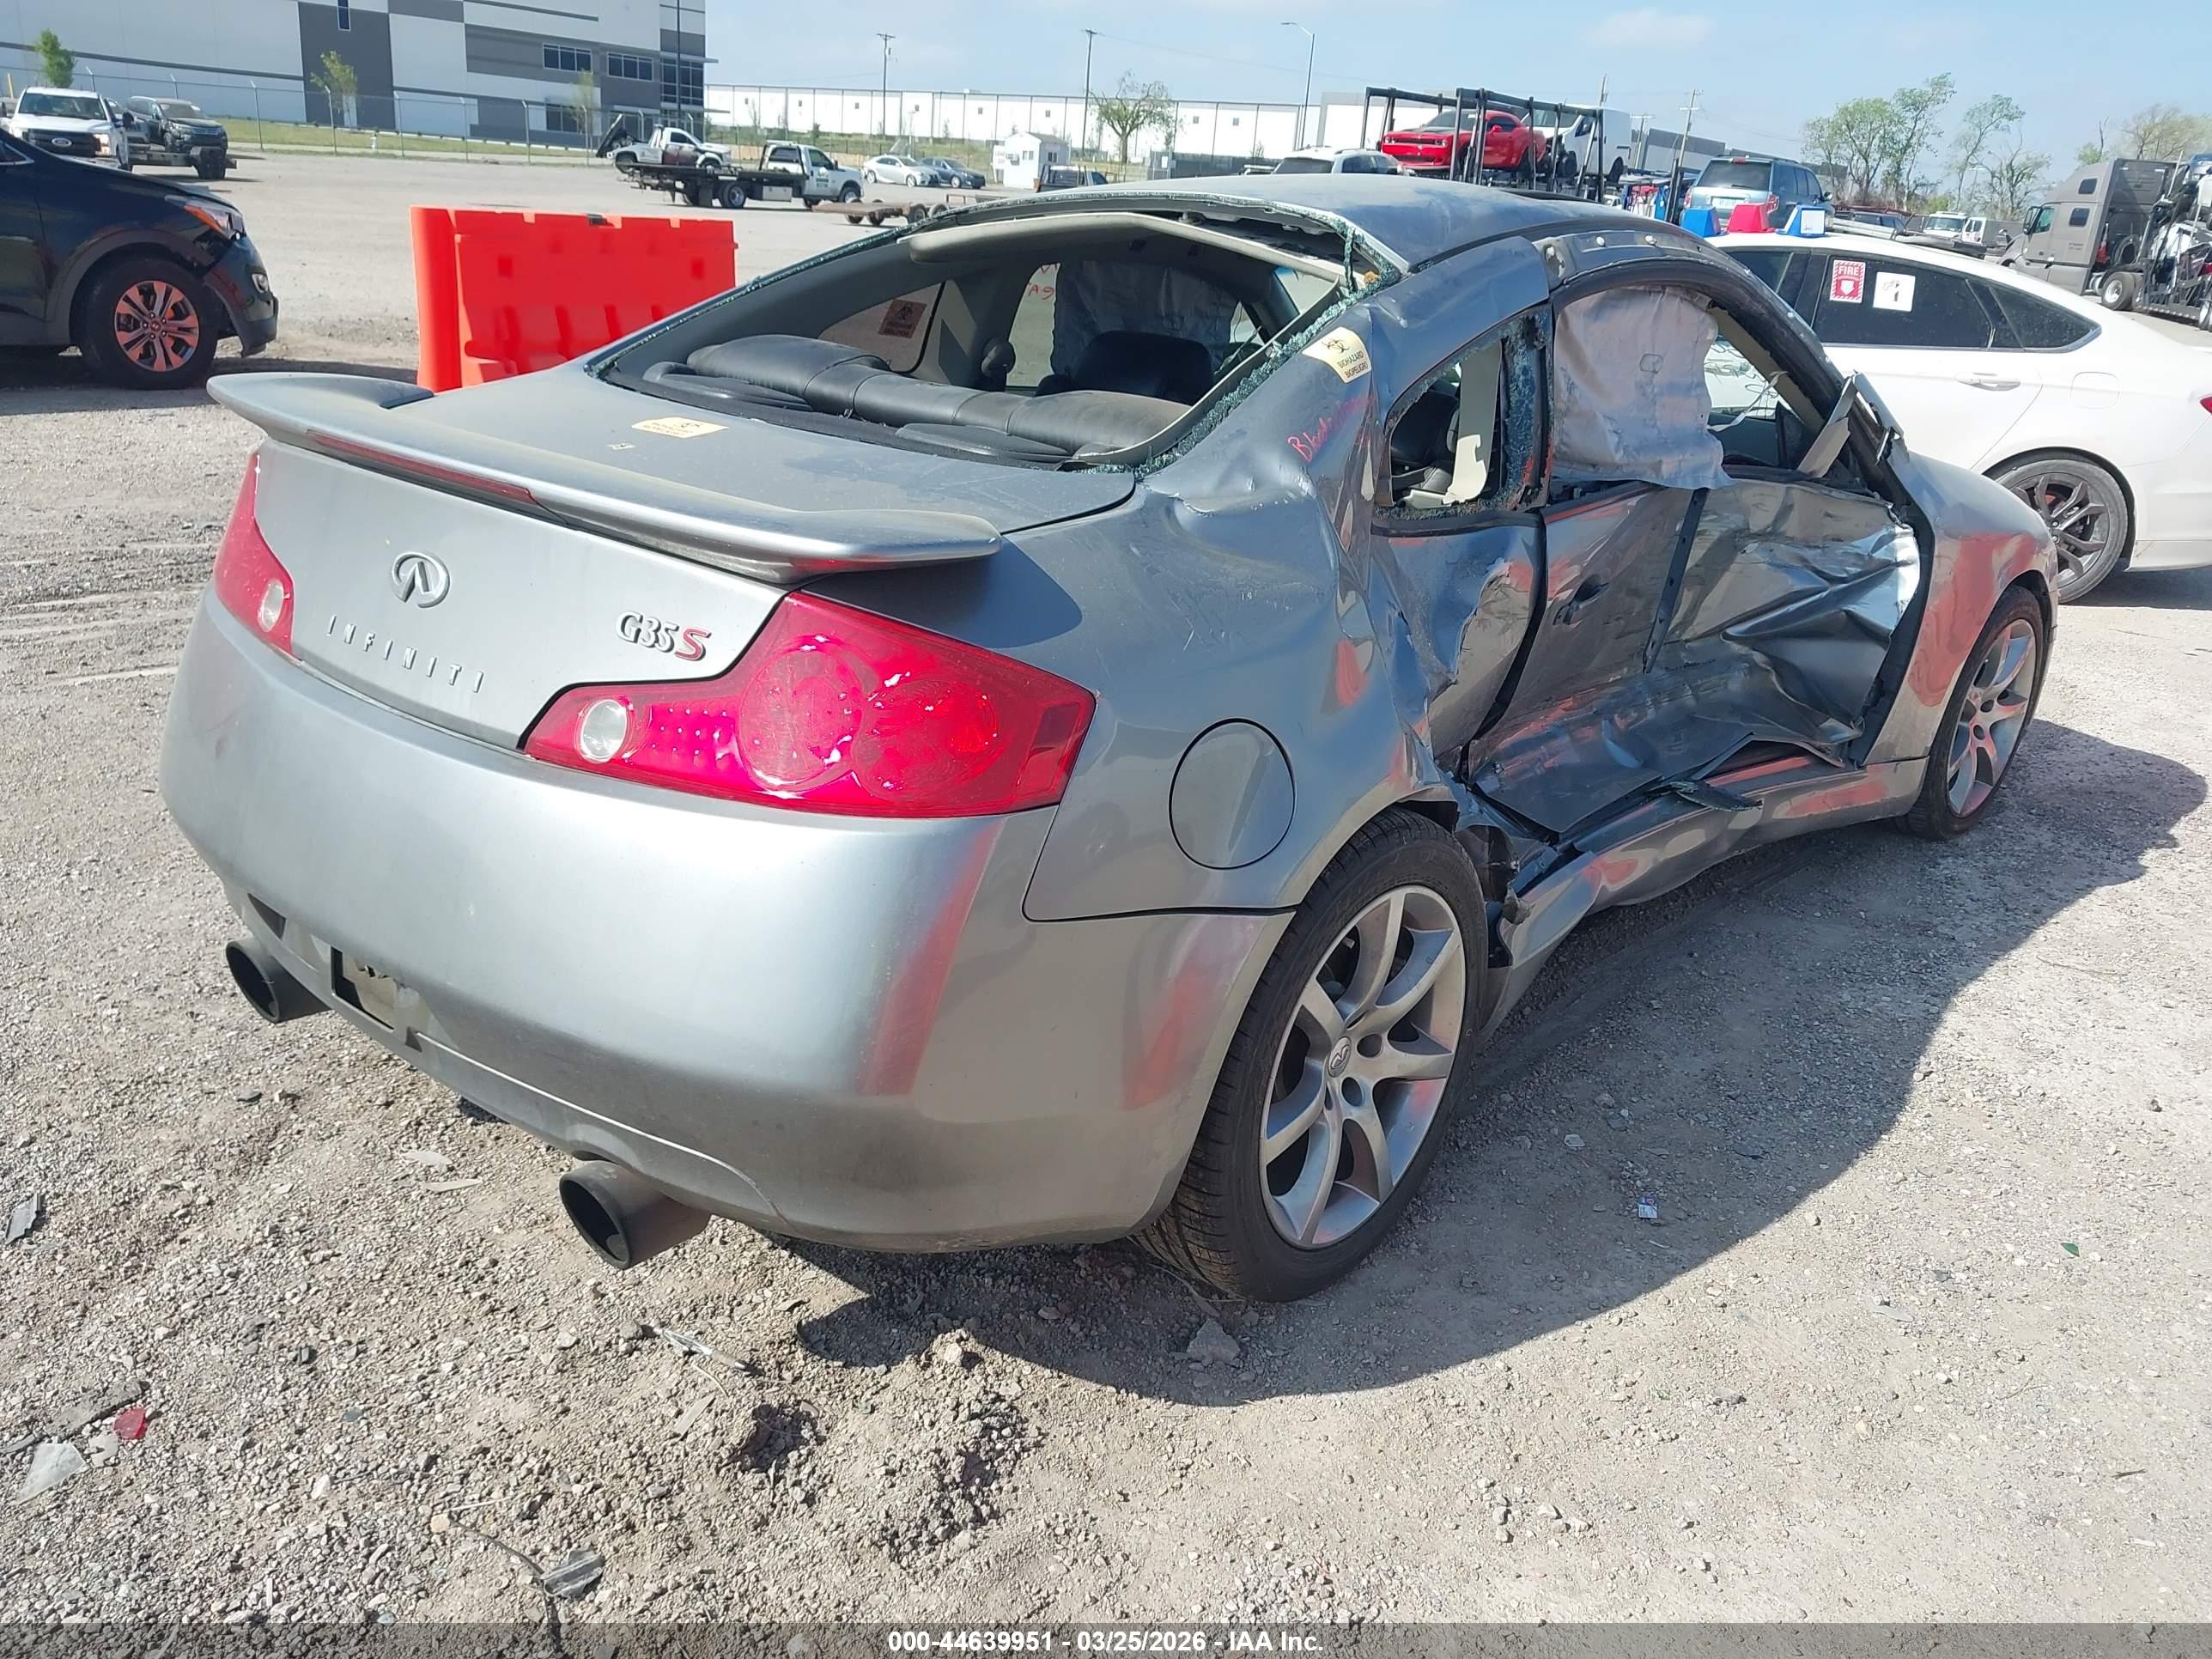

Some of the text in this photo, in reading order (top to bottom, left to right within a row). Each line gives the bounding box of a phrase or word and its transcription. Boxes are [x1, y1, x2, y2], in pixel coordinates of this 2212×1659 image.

[1838, 265, 1860, 276] FIRE
[1337, 349, 1364, 369] BIOHAZARD
[326, 615, 484, 694] INFINITI
